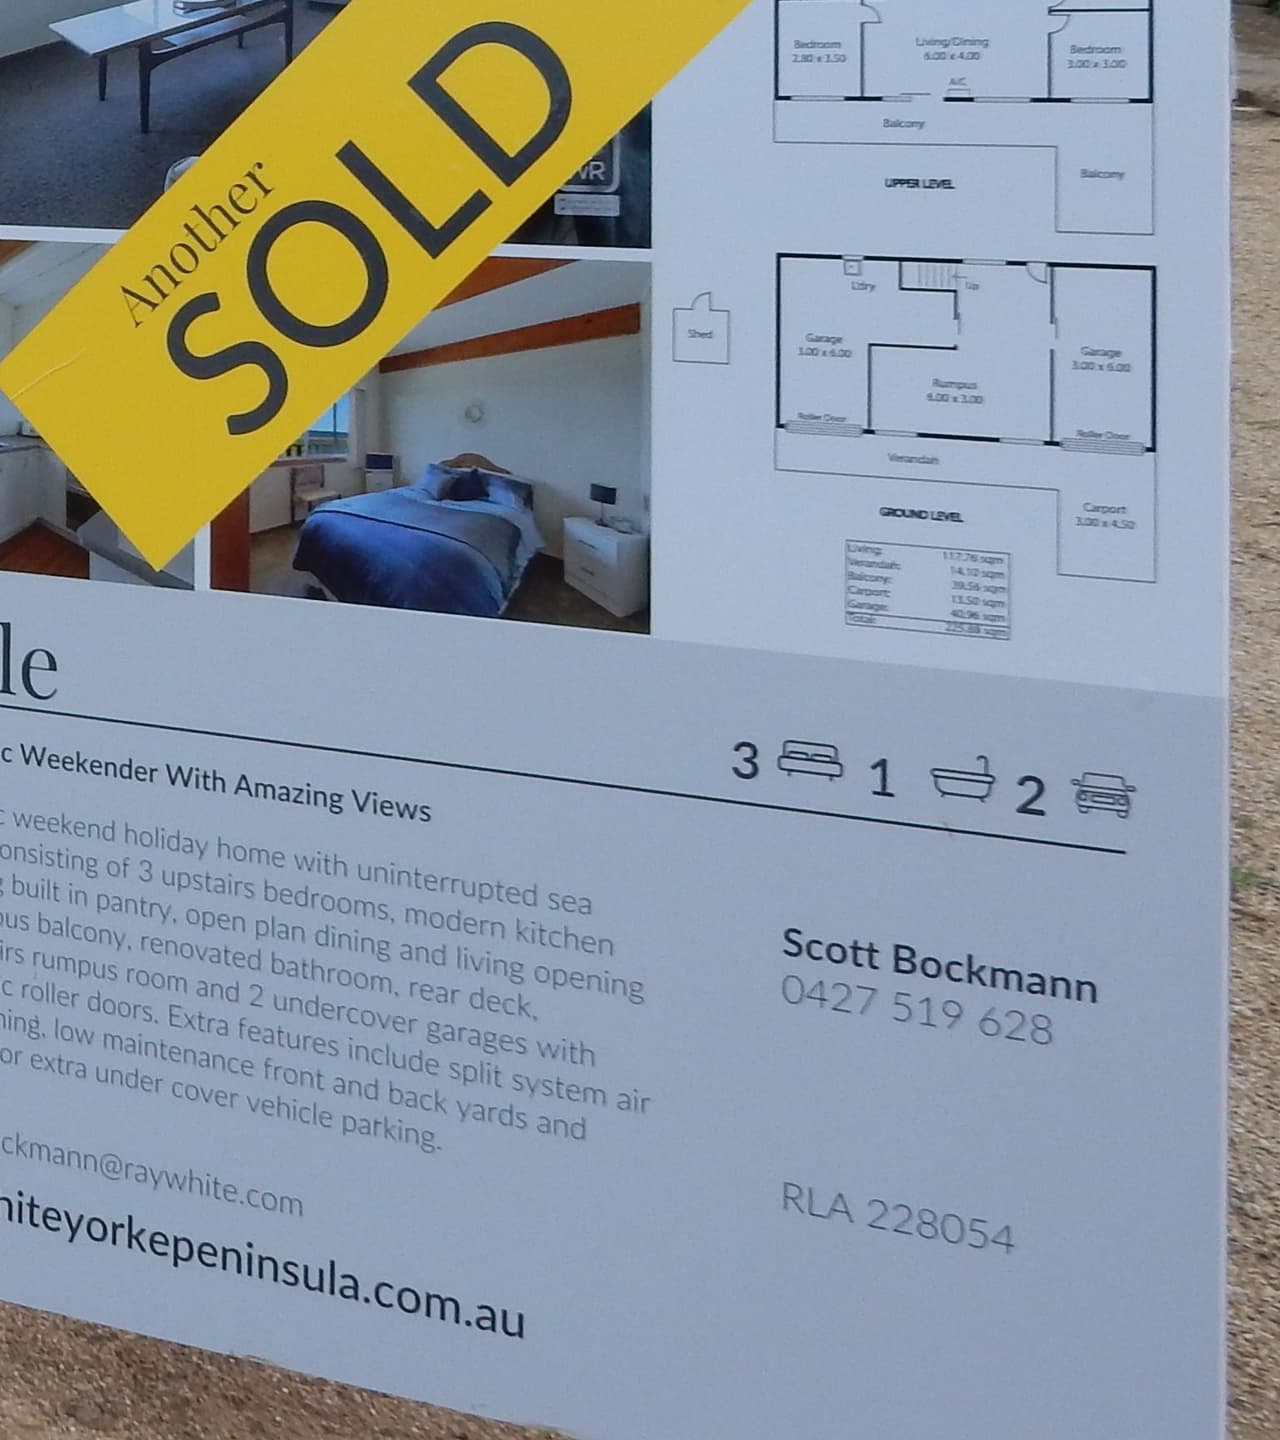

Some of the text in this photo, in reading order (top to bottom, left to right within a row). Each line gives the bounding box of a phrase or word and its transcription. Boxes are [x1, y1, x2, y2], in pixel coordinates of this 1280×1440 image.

[793, 40, 842, 50] Bedroom
[915, 36, 990, 48] Living/Dining
[1070, 44, 1122, 55] Bedroom
[882, 118, 926, 130] Balcony
[884, 177, 956, 189] UPPER LEVEL
[1079, 168, 1126, 181] Balcony
[120, 161, 275, 328] Another
[166, 21, 572, 436] SOLD
[687, 328, 714, 339] Shed
[805, 332, 844, 345] Garage
[1080, 345, 1123, 359] Garage
[932, 378, 978, 391] Rumpus
[879, 506, 965, 523] GROUND LEVEL
[1082, 501, 1127, 514] Carport
[20, 744, 158, 783] Weekender
[166, 764, 225, 793] With
[234, 774, 344, 814] Amazing
[352, 789, 431, 822] Views
[732, 740, 1046, 817] 3 1 2
[13, 812, 115, 842] weekend
[125, 822, 208, 860] holiday
[218, 836, 285, 868] home
[294, 851, 348, 877] with
[358, 862, 538, 907] uninterrupted
[548, 893, 592, 915] sea
[12, 873, 60, 902] built
[69, 883, 87, 907] in
[97, 894, 176, 924] pantry,
[186, 909, 245, 933] open
[256, 915, 305, 944] plan
[315, 924, 391, 962] dining
[400, 944, 446, 966] and
[457, 946, 524, 985] living
[534, 966, 644, 1005] opening
[106, 857, 130, 878] of
[139, 860, 152, 882] 3
[162, 870, 255, 899] upstairs
[264, 879, 395, 924] bedrooms,
[405, 908, 505, 939] modern
[516, 918, 613, 956] kitchen
[38, 912, 131, 952] balcony,
[141, 936, 261, 971] renovated
[272, 952, 399, 997] bathroom,
[410, 982, 460, 1004] rear
[783, 928, 1097, 1003] Scott Bockmann
[33, 952, 118, 981] rumpus
[127, 968, 187, 994] room
[196, 980, 239, 1002] and
[250, 984, 263, 1008] 2
[274, 994, 418, 1033] undercover
[426, 1021, 528, 1054] garages
[536, 1038, 595, 1067] with
[782, 975, 1053, 1045] 0427 519 628
[22, 981, 80, 1008] roller
[88, 990, 158, 1024] doors.
[169, 1004, 228, 1036] Extra
[239, 1017, 339, 1056] features
[349, 1037, 440, 1076] include
[449, 1061, 502, 1088] split
[512, 1074, 607, 1106] system
[617, 1089, 651, 1113] air
[55, 1017, 94, 1045] low
[104, 1033, 254, 1077] maintenance
[264, 1057, 325, 1091] front
[333, 1077, 378, 1101] and
[389, 1081, 447, 1114] back
[456, 1101, 527, 1129] yards
[537, 1116, 586, 1140] and
[31, 1054, 86, 1079] extra
[96, 1066, 163, 1093] under
[172, 1082, 239, 1108] cover
[247, 1096, 332, 1128] vehicle
[343, 1115, 442, 1153] parking.
[783, 1182, 1016, 1254] RLA 228054
